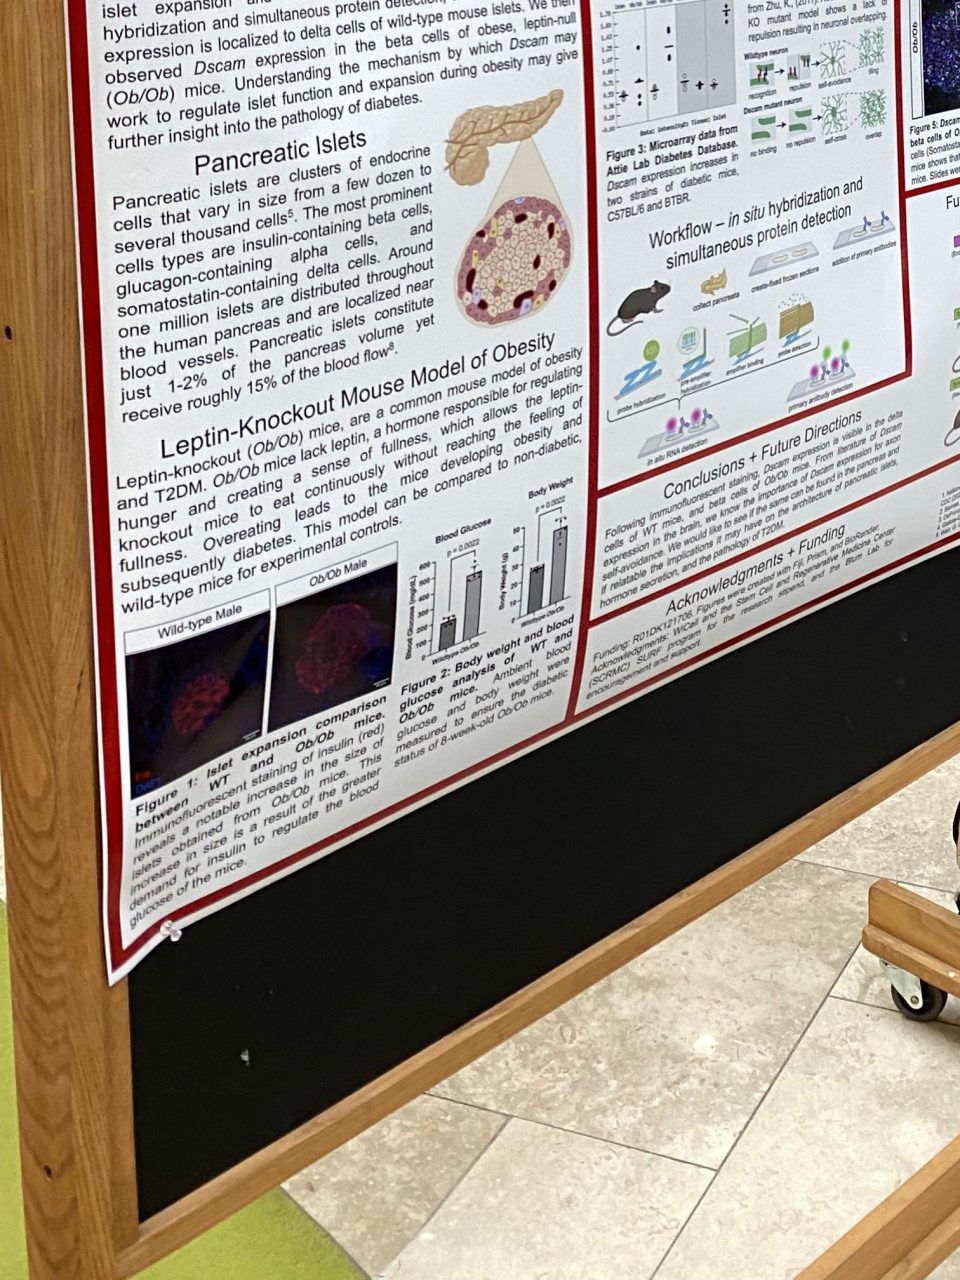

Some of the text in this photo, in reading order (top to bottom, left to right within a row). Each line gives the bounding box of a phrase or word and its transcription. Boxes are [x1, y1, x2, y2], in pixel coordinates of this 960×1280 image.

[113, 146, 430, 211] Pancreatic islets are clusters of endocrine
[195, 130, 367, 175] Pancreatic Islets
[649, 220, 712, 248] Workflow
[728, 212, 739, 228] in
[744, 205, 765, 225] situ
[768, 185, 840, 217] hybridization
[843, 176, 863, 196] and
[666, 203, 851, 270] simultaneous protein detection
[161, 332, 555, 458] Leptin-Knockout Mouse Model of Obesity
[663, 456, 745, 499] Conclusions
[761, 436, 800, 461] Future
[805, 410, 861, 441] Directions
[309, 558, 367, 588] Ob/Ob Male
[666, 551, 783, 615] Acknowledgments
[799, 524, 845, 552] Funding
[158, 604, 242, 640] Wild-type Male
[401, 614, 574, 696] Figure 2: Body weight and blood
